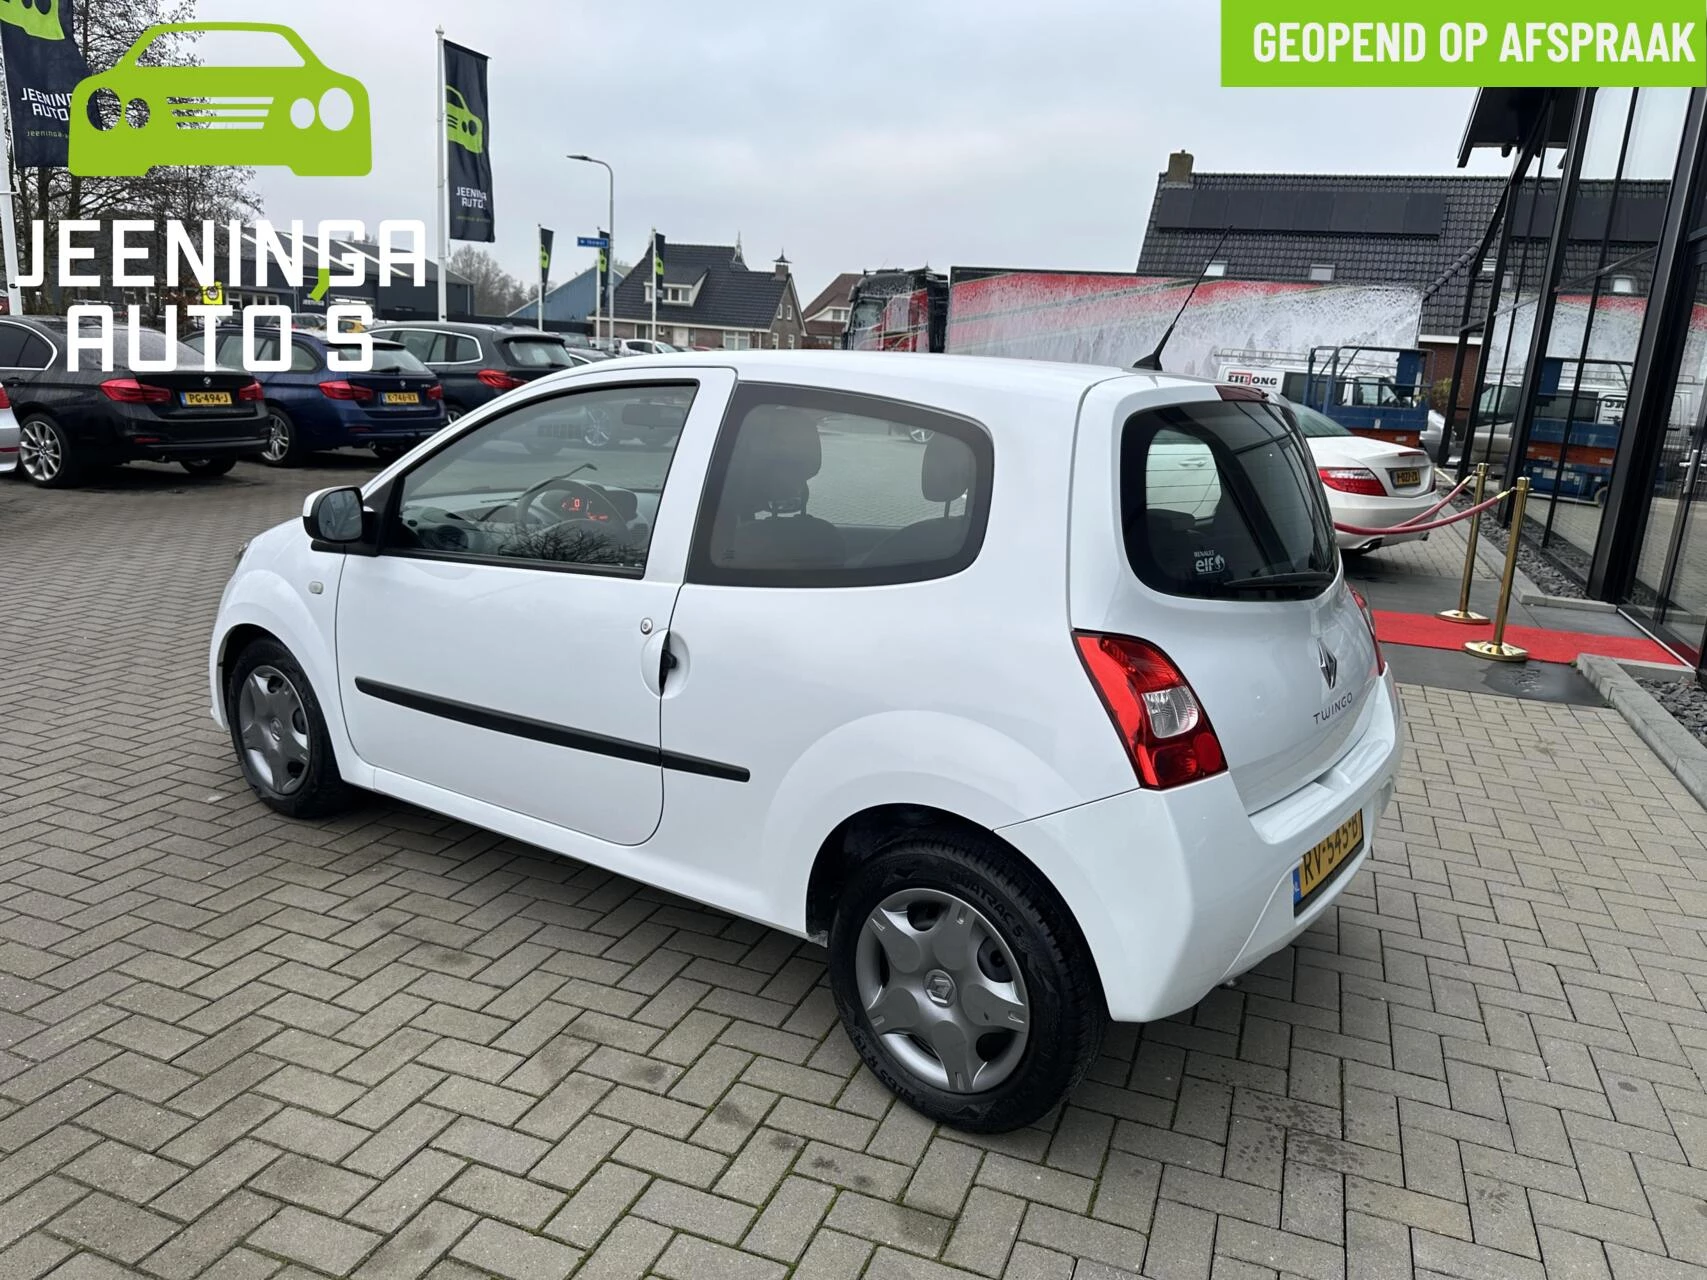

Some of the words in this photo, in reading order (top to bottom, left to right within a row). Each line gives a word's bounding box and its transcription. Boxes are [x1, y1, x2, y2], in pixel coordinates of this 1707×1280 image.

[1196, 557, 1214, 572] elf
[1313, 692, 1353, 725] TWINGO
[1302, 812, 1359, 886] RV-545-B
